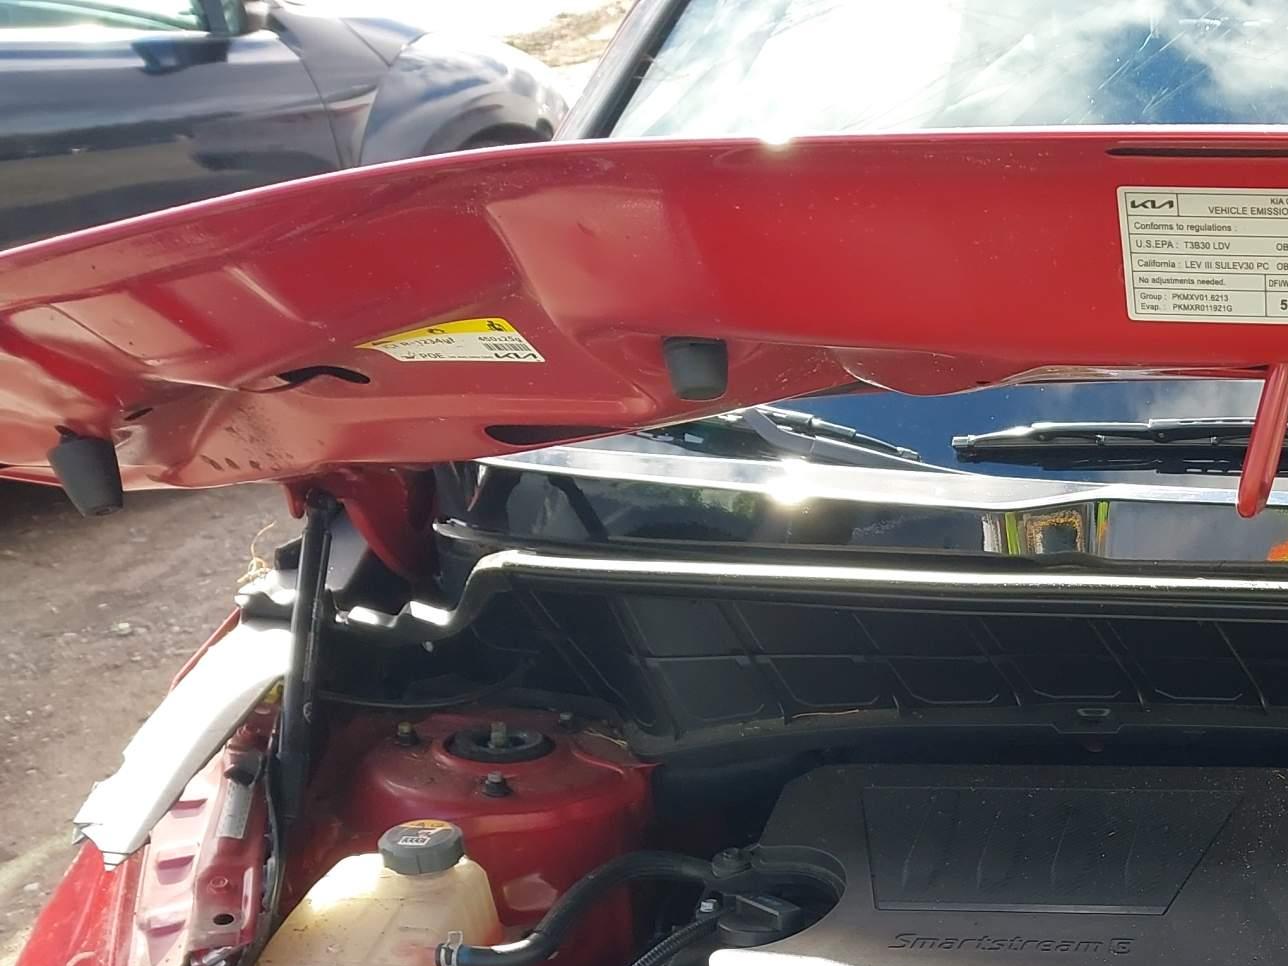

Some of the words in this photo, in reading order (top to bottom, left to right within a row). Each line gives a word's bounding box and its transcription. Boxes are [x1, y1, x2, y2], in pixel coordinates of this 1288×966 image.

[1130, 199, 1174, 209] KIA
[1208, 206, 1248, 215] VEHICLE
[1134, 221, 1174, 230] Conforms
[1176, 222, 1184, 230] to
[1184, 241, 1211, 250] T3B30
[1213, 241, 1230, 250] LDV
[1185, 261, 1201, 269] LEV
[1204, 261, 1213, 269] III
[1215, 262, 1254, 270] SULEV30
[1256, 262, 1269, 270] PC
[1139, 276, 1149, 284] No
[1151, 277, 1195, 287] adjustments
[887, 932, 1105, 951] Smartstream
